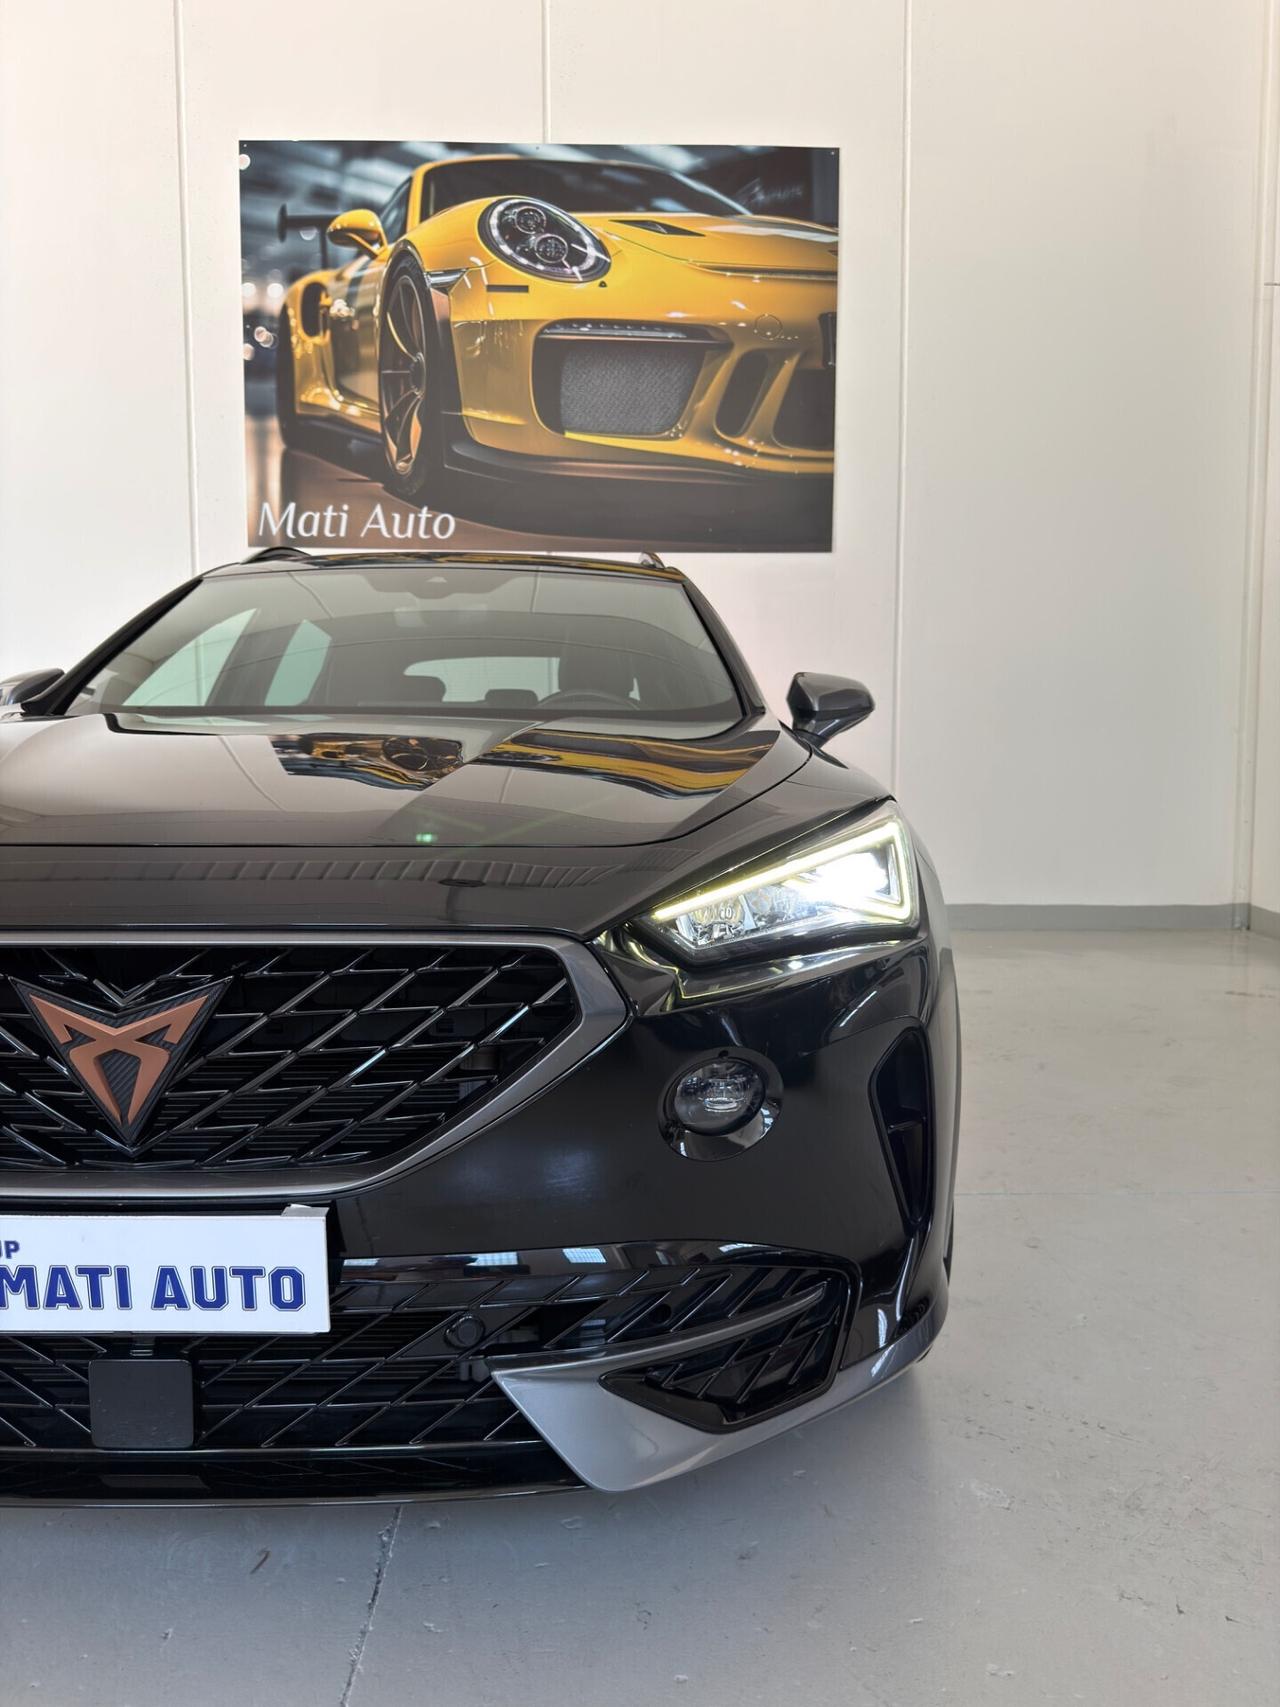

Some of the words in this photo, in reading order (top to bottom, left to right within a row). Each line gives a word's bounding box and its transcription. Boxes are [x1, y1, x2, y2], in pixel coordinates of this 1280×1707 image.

[258, 502, 349, 539] Mati
[360, 503, 456, 540] Auto
[0, 1240, 20, 1259] P
[0, 1264, 132, 1310] MATI
[151, 1265, 306, 1312] AUTO
